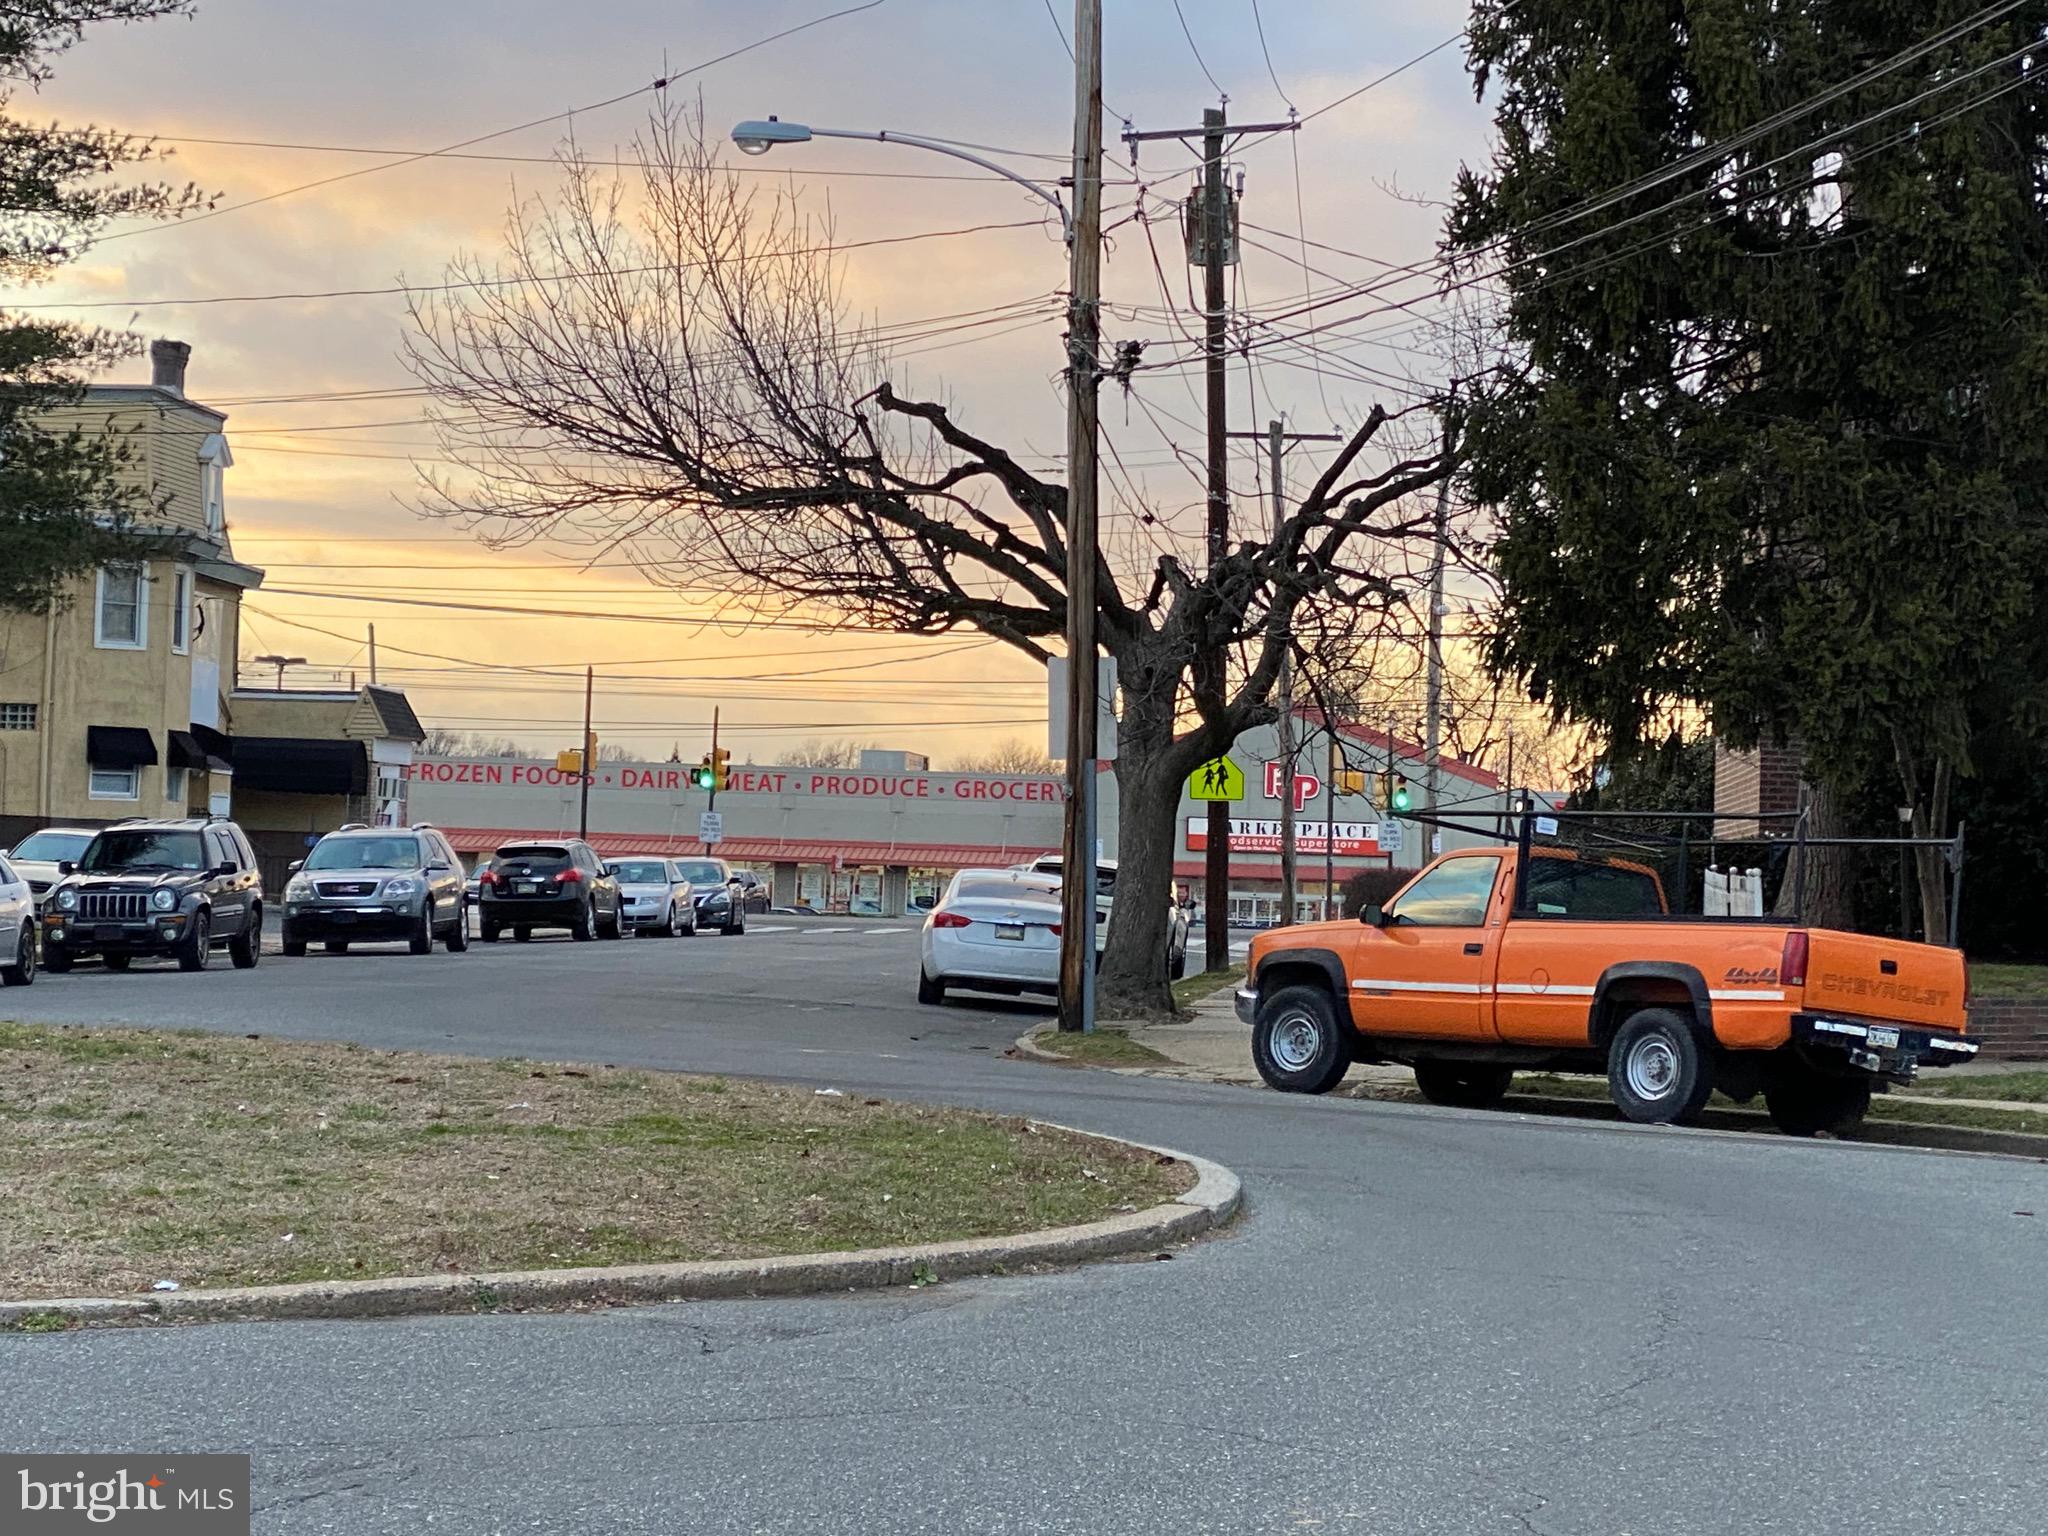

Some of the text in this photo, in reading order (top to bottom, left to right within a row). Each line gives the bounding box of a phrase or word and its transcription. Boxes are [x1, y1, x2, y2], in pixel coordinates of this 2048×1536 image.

[406, 762, 501, 784] FROZEN
[622, 768, 691, 790] DAIRY
[811, 775, 928, 798] PRODUCE
[954, 780, 1066, 802] GROCERY
[1821, 973, 1950, 1007] CHEVROLET
